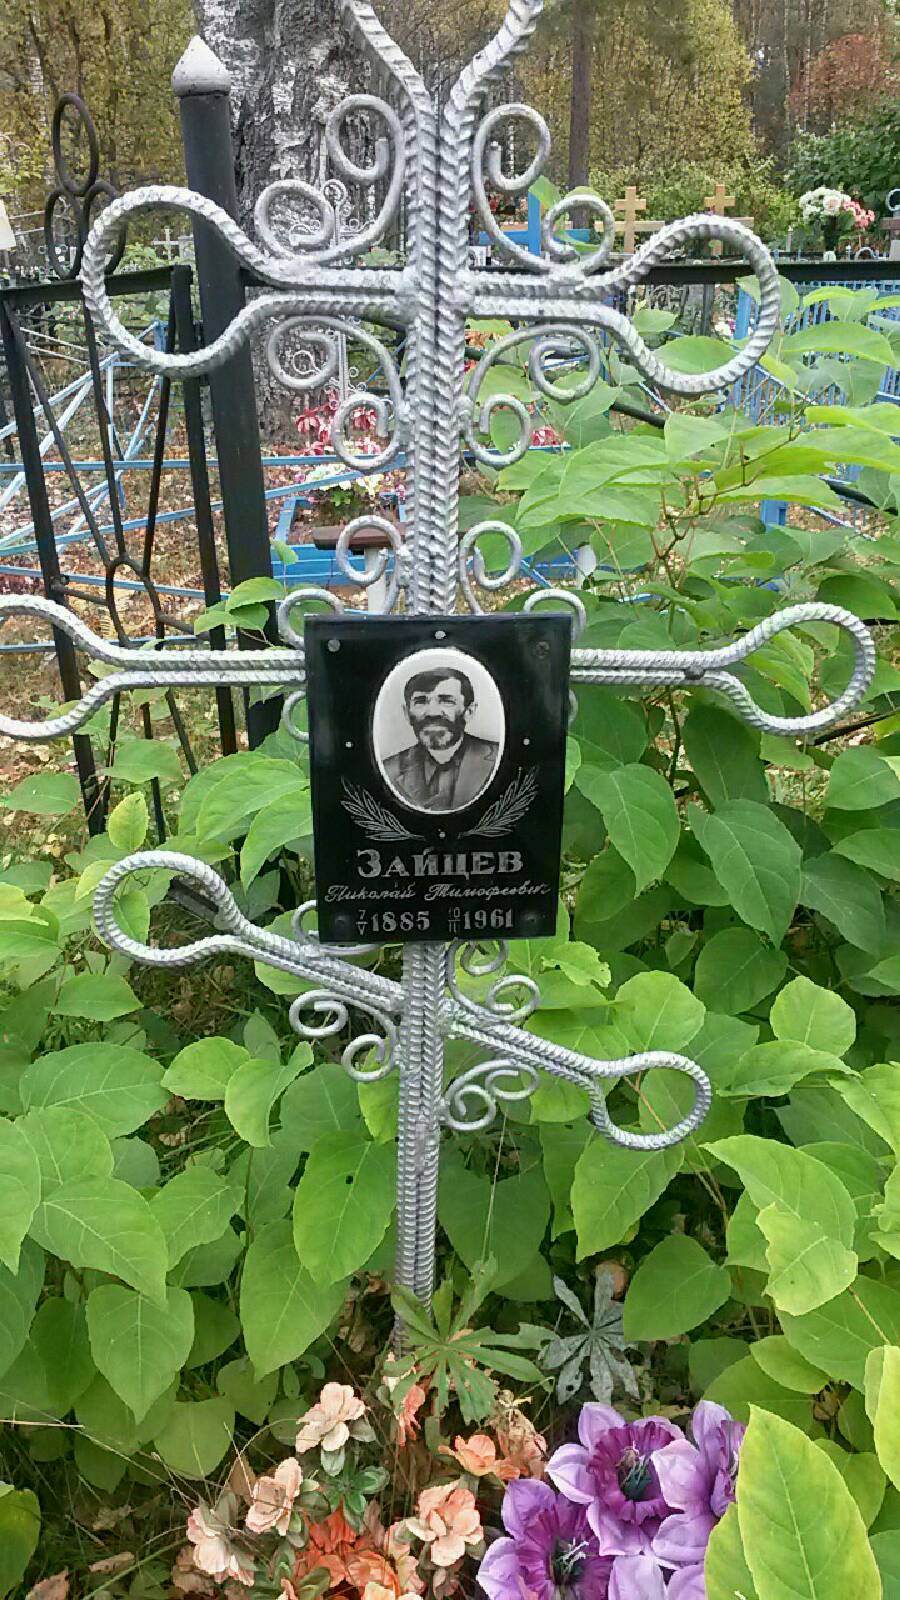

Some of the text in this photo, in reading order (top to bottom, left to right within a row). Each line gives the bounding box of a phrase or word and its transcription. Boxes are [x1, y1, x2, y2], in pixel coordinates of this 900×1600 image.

[356, 846, 524, 880] ЗАЙЦЕВ
[324, 881, 416, 902] Николай
[371, 911, 431, 932] 1885
[463, 907, 514, 931] 1961
